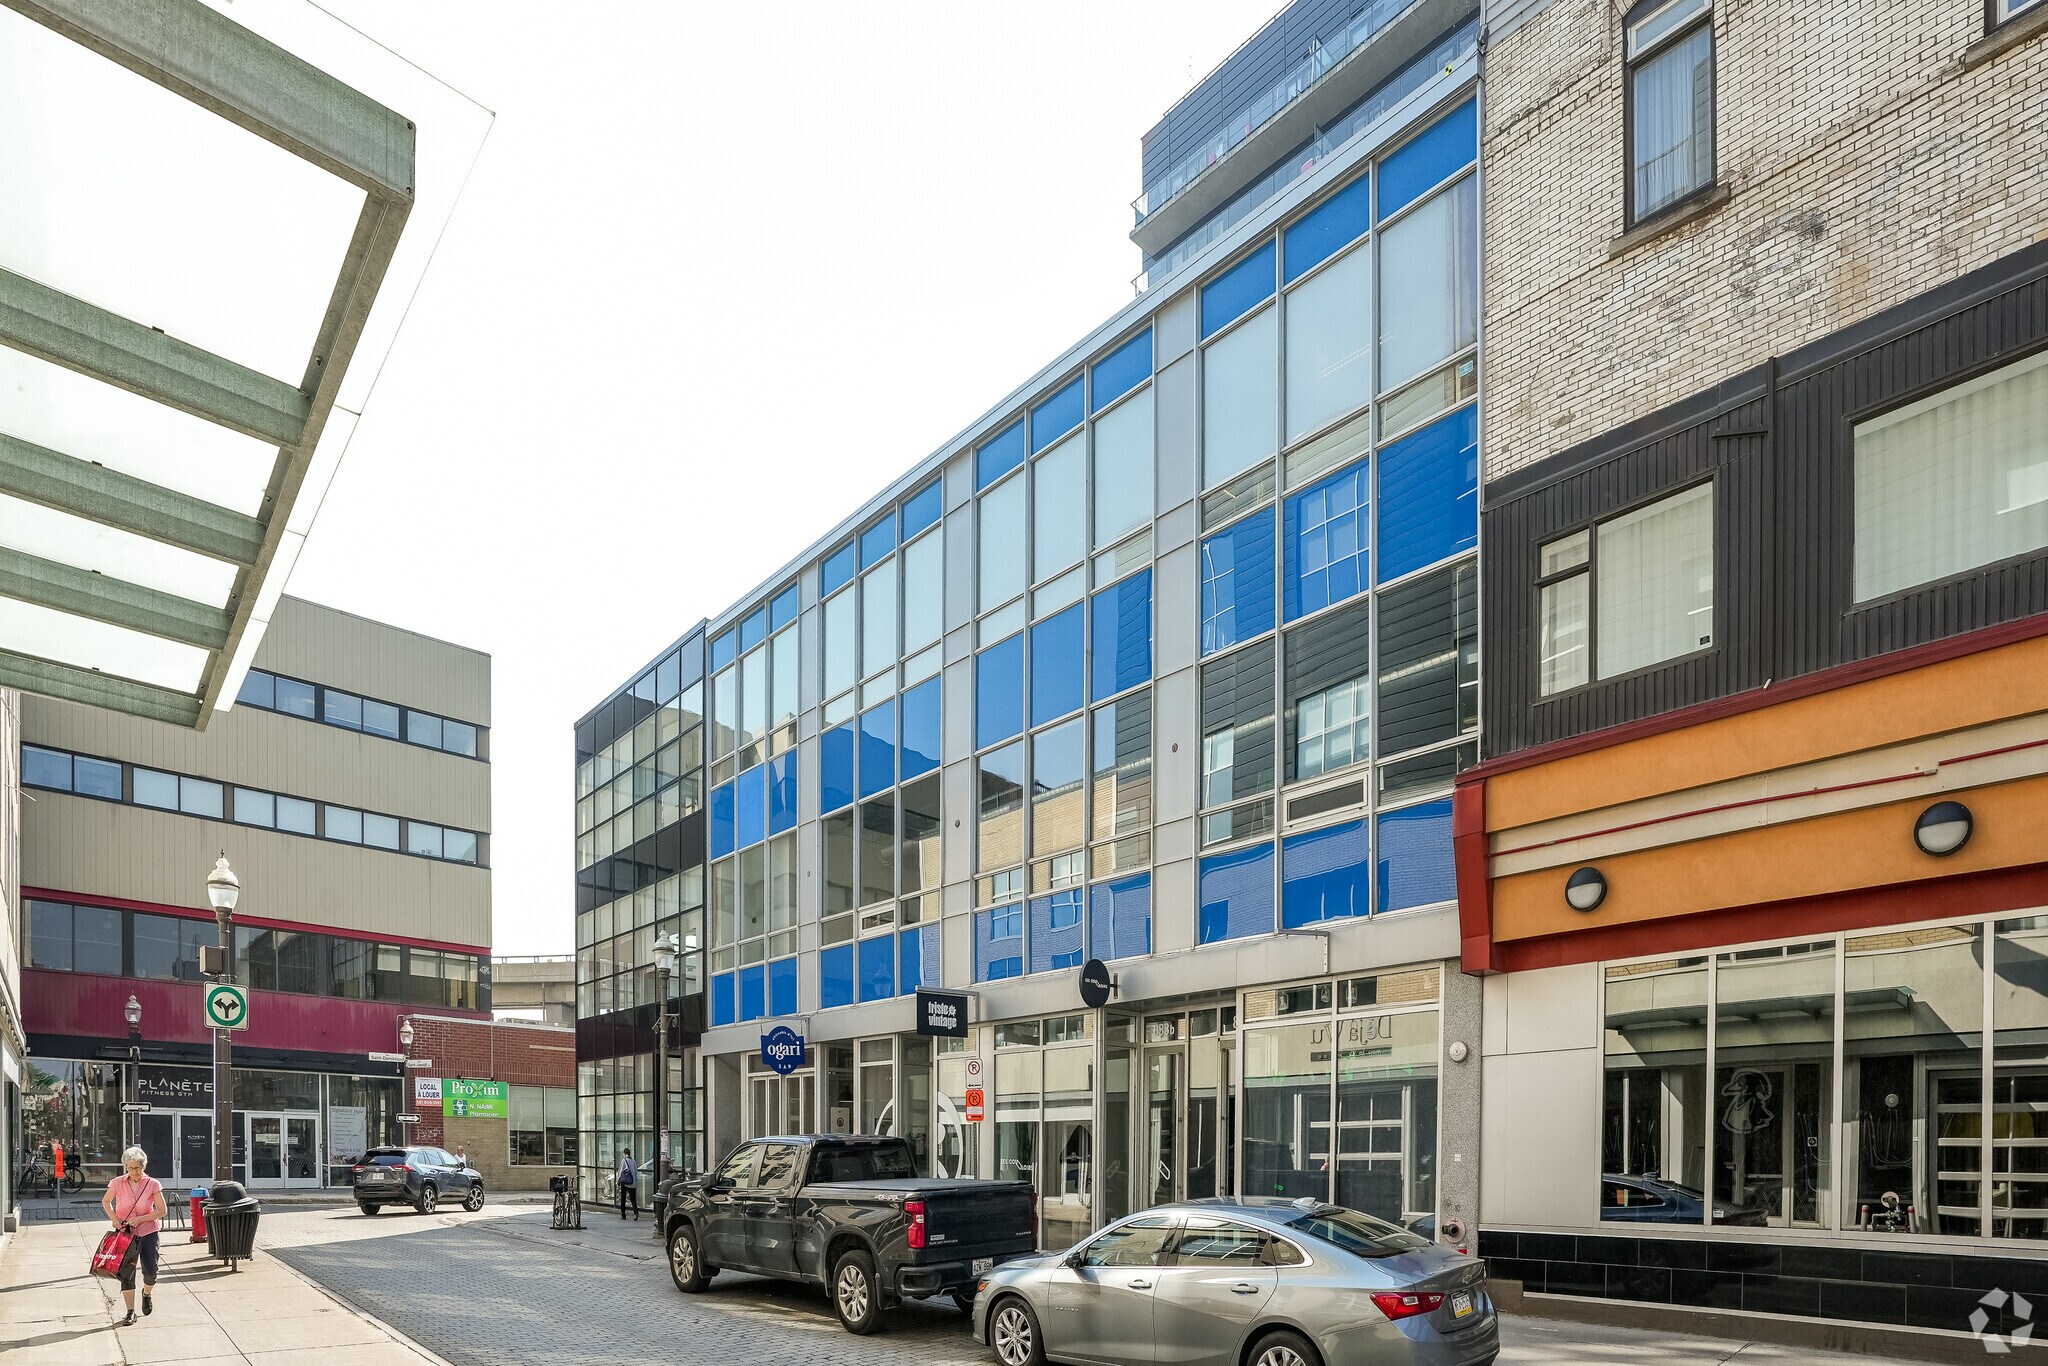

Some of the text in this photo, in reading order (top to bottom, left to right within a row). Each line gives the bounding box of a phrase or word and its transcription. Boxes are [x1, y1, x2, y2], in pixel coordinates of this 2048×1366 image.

[928, 1014, 957, 1030] vintage
[768, 1041, 800, 1060] ogari
[138, 1077, 214, 1093] PLANÈTE
[419, 1083, 438, 1091] LOCAL
[451, 1081, 500, 1098] Proxim
[422, 1091, 441, 1099] LOUER
